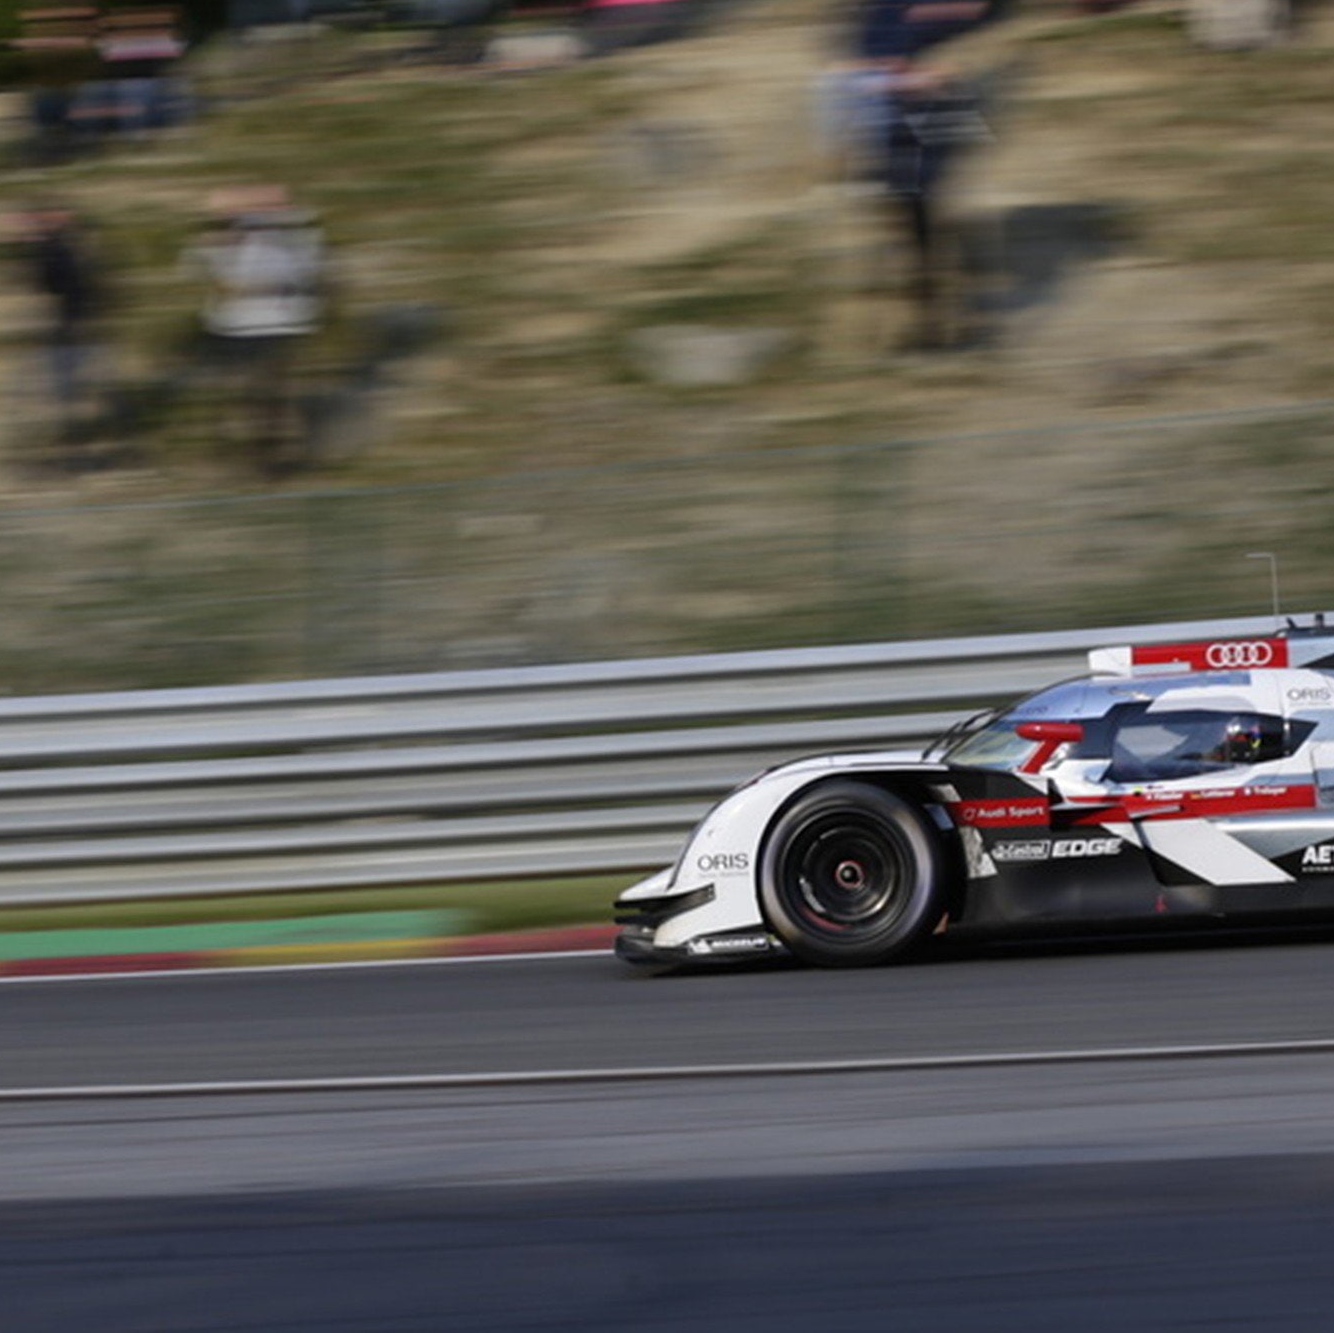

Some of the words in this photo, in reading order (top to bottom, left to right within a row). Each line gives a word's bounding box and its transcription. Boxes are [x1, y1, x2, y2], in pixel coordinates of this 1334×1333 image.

[1287, 686, 1331, 701] ORIS
[977, 807, 1006, 818] Audi
[1009, 805, 1045, 818] Sport
[1052, 838, 1123, 858] EDGE
[697, 853, 749, 872] ORIS
